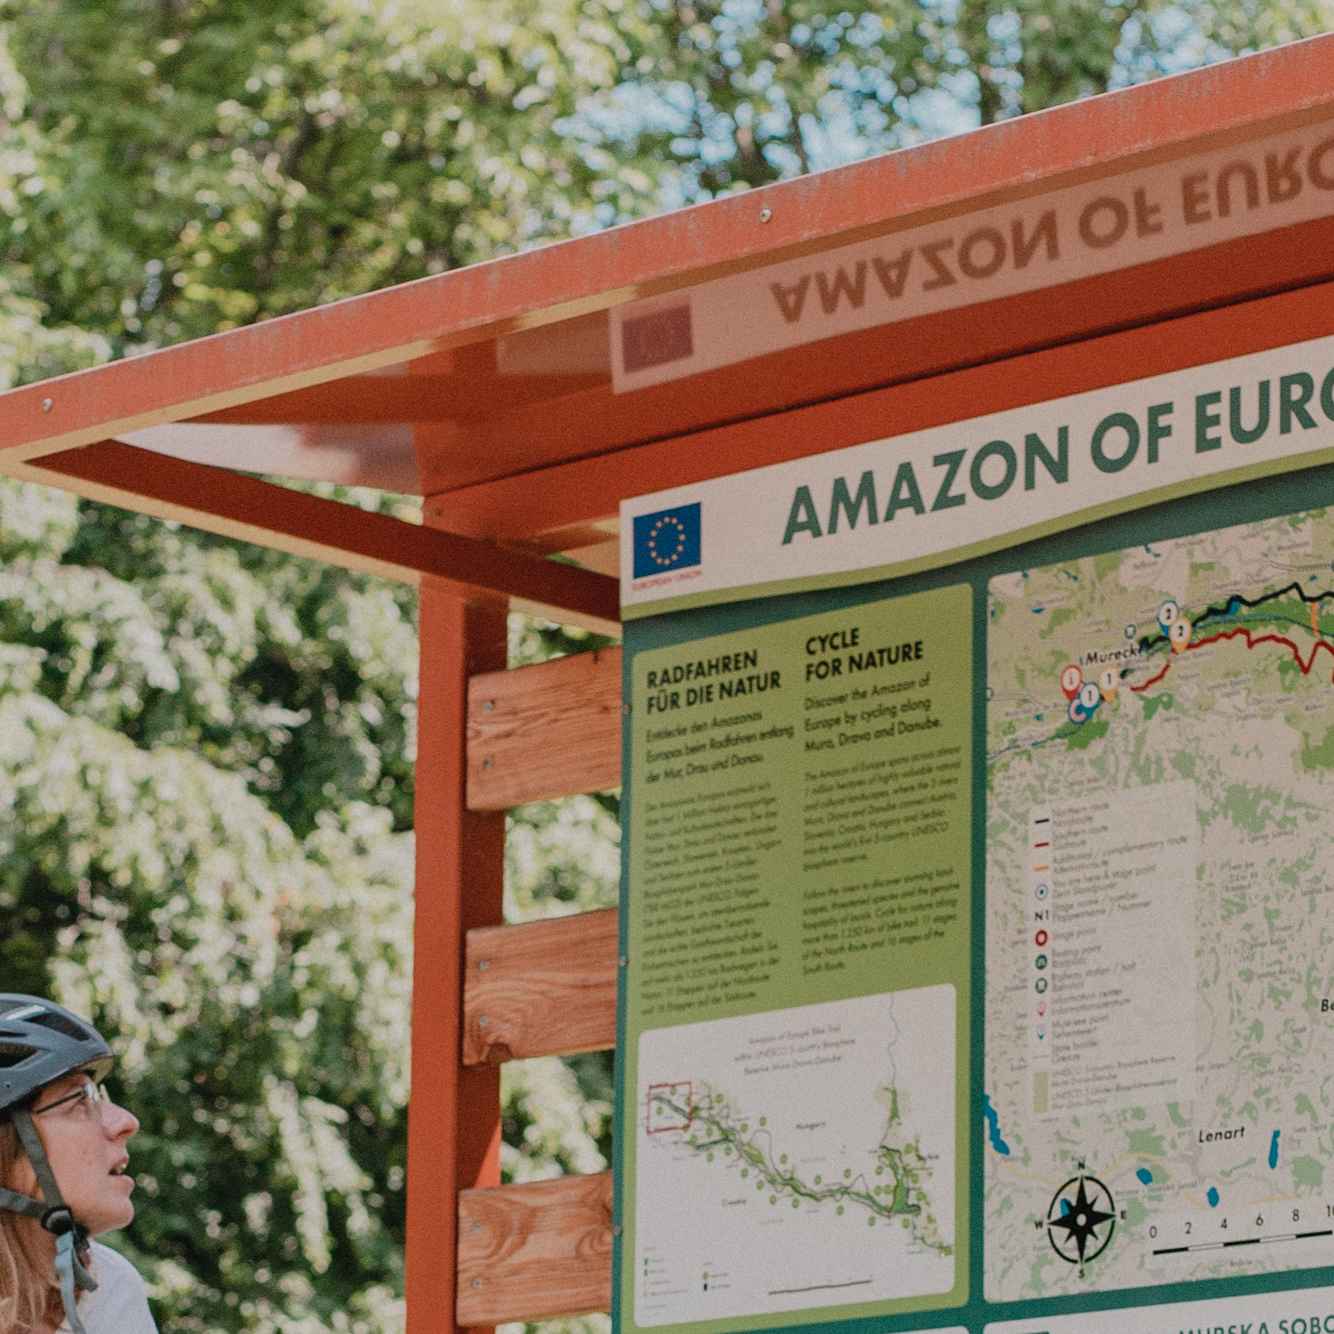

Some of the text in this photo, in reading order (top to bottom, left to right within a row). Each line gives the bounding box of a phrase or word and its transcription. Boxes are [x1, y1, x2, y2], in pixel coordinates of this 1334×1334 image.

[781, 425, 1069, 547] AMAZON
[1089, 400, 1175, 475] OF
[1177, 624, 1184, 637] 2
[805, 628, 859, 655] CYCLE
[805, 641, 924, 681] FOR NATURE
[1085, 647, 1141, 666] Mureck
[647, 650, 758, 689] RADFAHREN
[646, 671, 781, 715] FÜR DIE NATUR
[839, 729, 870, 746] Drava
[1034, 909, 1050, 920] N1
[1199, 1126, 1245, 1143] Lenart
[1035, 1220, 1044, 1228] W
[1121, 1211, 1126, 1219] E
[1149, 1225, 1157, 1239] 0
[1185, 1221, 1191, 1235] 2
[1221, 1217, 1228, 1230] 4
[1256, 1214, 1264, 1228] 6
[1292, 1209, 1299, 1222] 8
[1079, 1270, 1085, 1278] S
